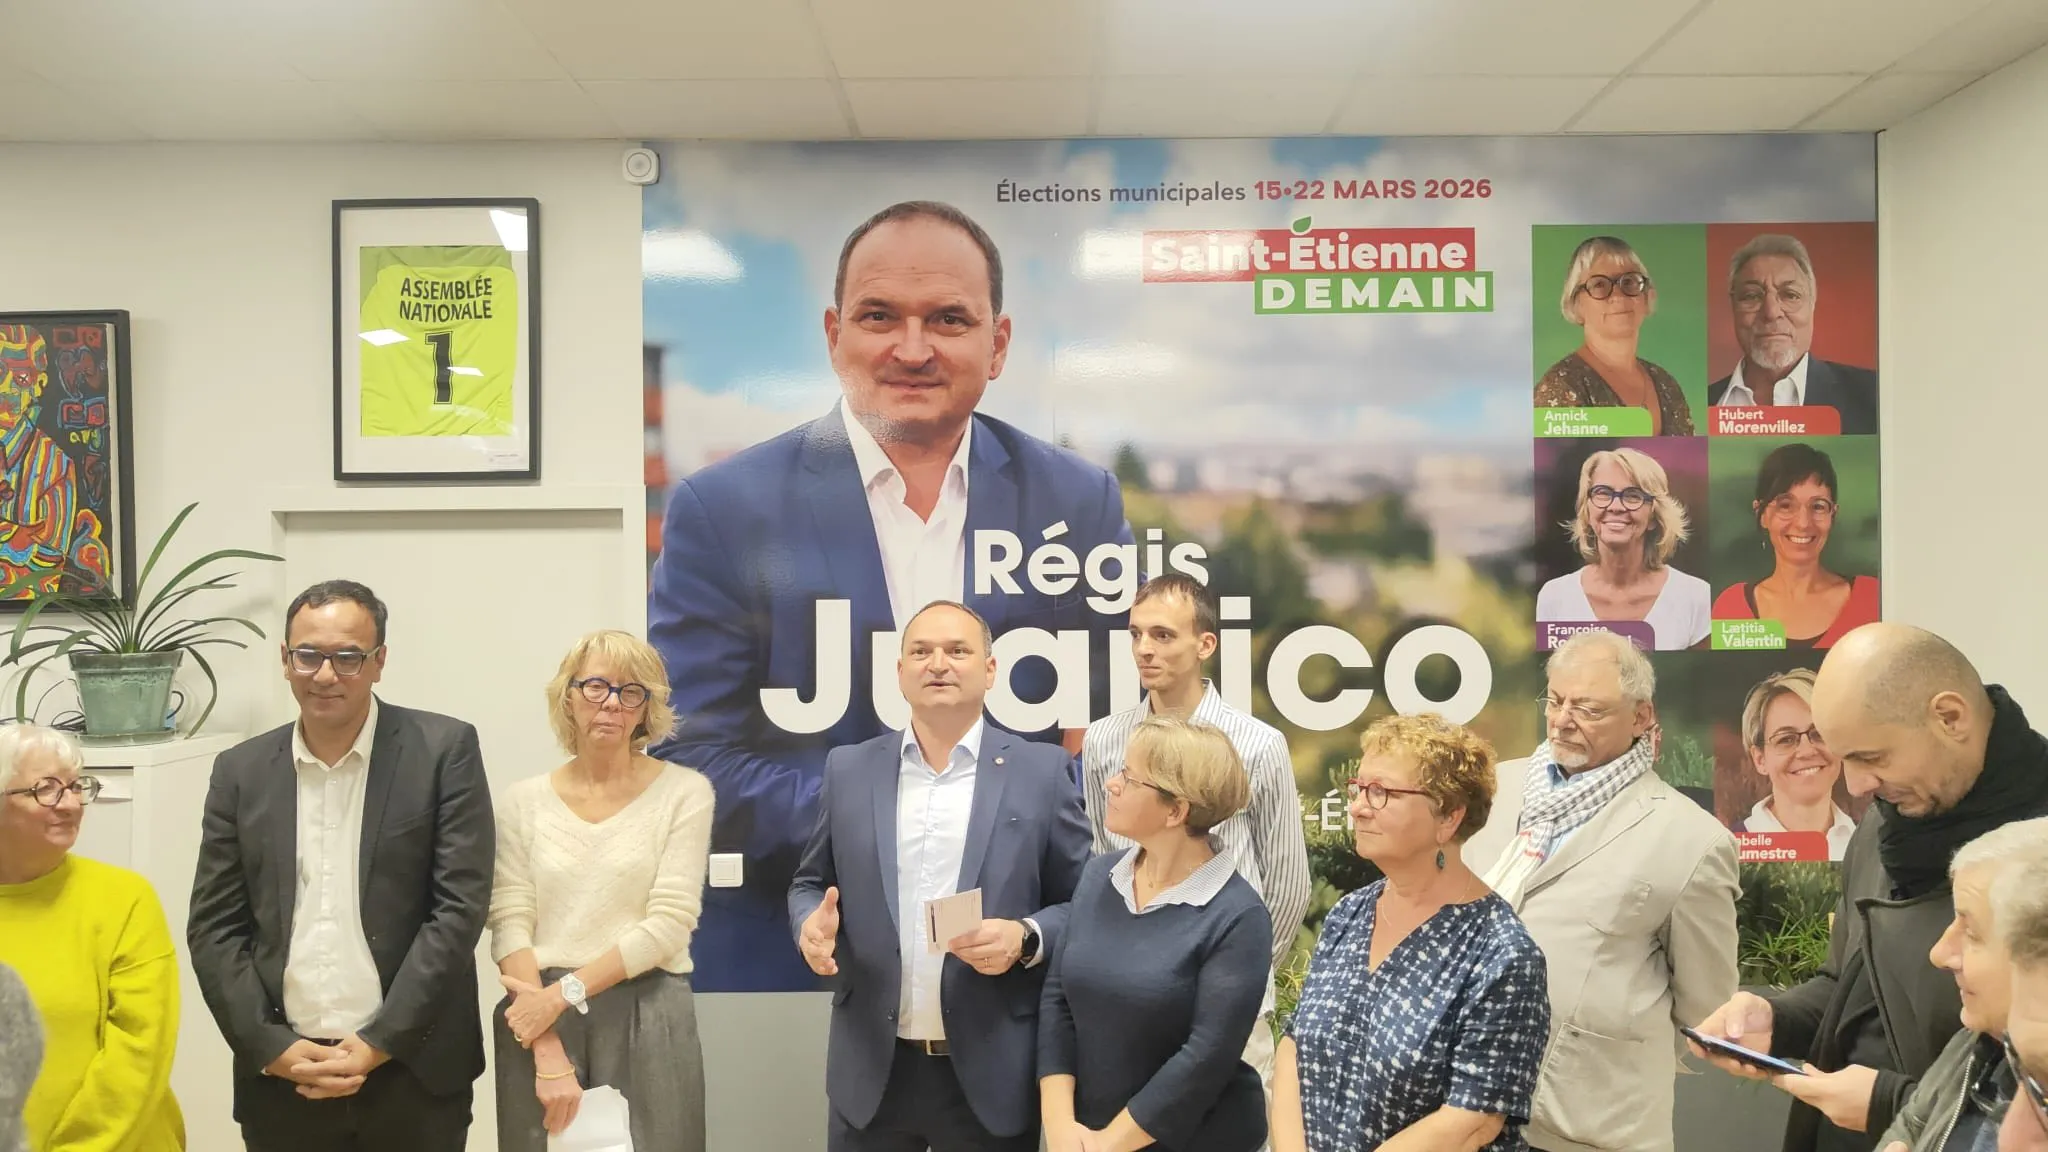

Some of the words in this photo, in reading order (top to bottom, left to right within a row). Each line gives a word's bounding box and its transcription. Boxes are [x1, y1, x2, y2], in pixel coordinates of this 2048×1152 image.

[996, 178, 1102, 203] Élections
[1108, 180, 1247, 206] municipales
[1333, 179, 1417, 200] MARS
[1424, 178, 1492, 199] 2026
[1150, 217, 1468, 273] Saint-Étienne
[400, 275, 493, 301] ASSEMBLÉE
[1261, 276, 1487, 310] DEMAIN
[399, 299, 493, 323] NATIONALE
[425, 330, 453, 405] 1
[1543, 409, 1589, 422] Annick
[1718, 407, 1765, 420] Hubert
[1543, 421, 1609, 436] Jehanne
[1718, 419, 1806, 434] Morenvillez
[973, 520, 1210, 615] Régis
[1721, 621, 1766, 634] Lætitia
[1721, 632, 1784, 648] Valentin
